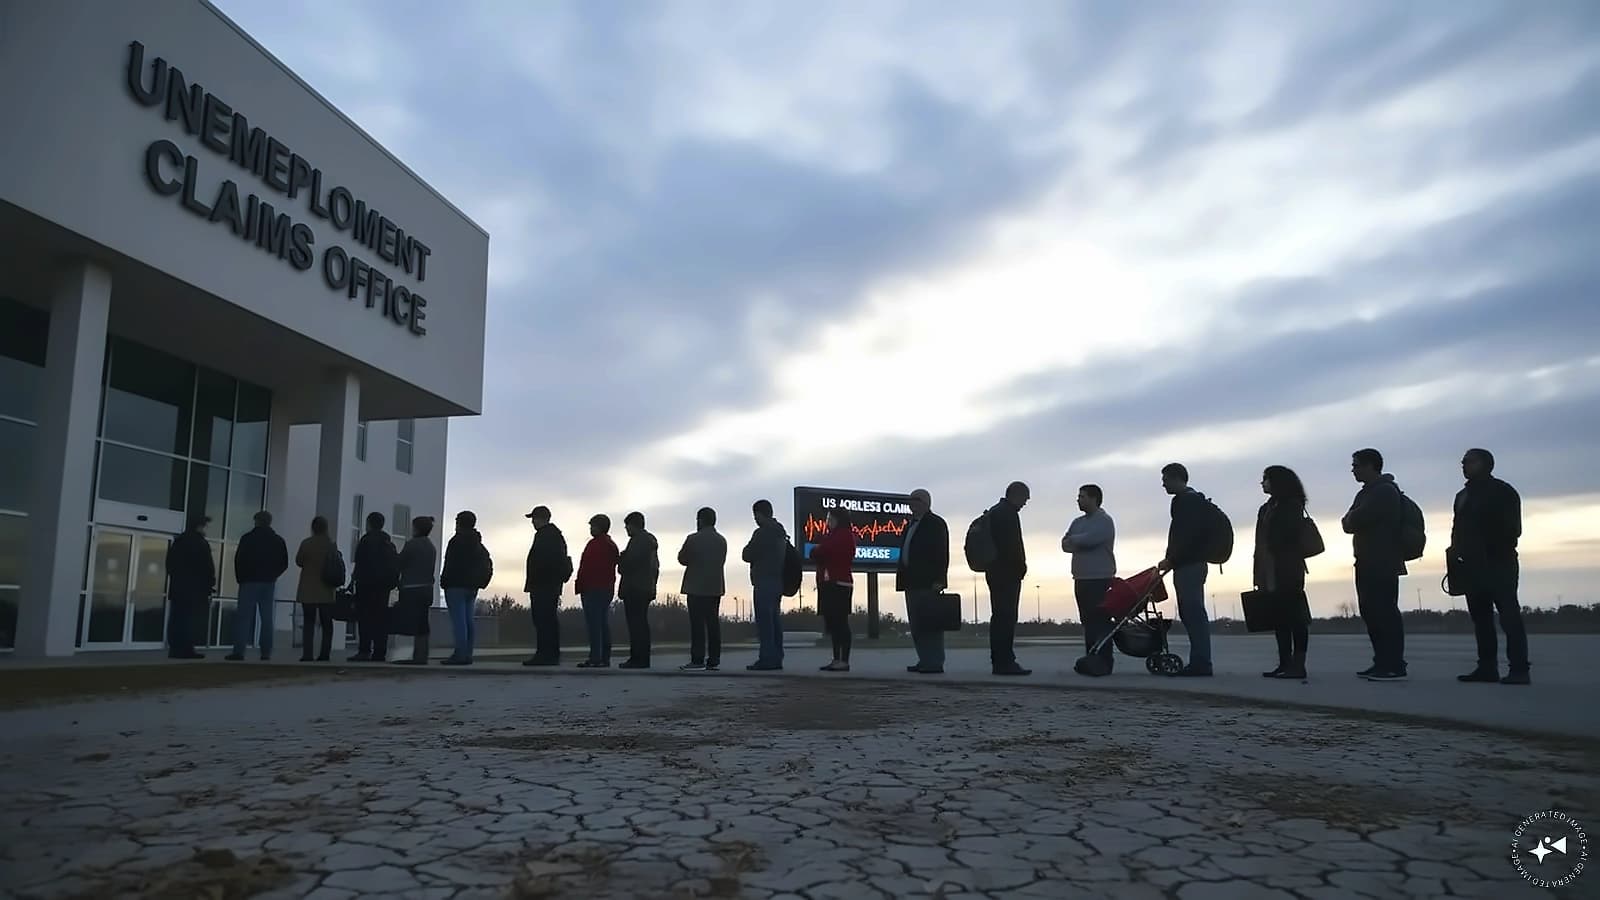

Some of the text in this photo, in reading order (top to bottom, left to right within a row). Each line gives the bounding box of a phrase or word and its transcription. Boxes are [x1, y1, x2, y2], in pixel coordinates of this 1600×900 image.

[128, 40, 430, 281] UNEMEPLOMENT
[146, 139, 426, 335] CLAIMS OFFICE
[822, 497, 836, 508] US
